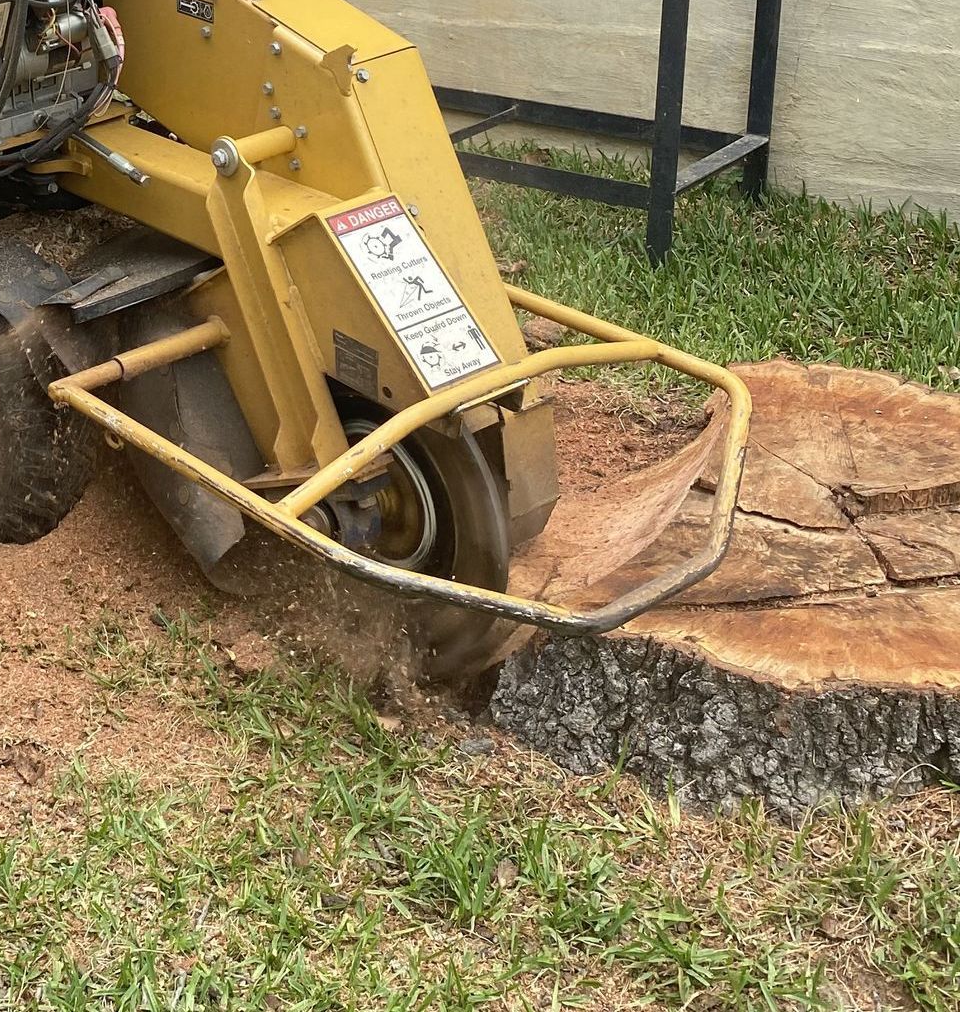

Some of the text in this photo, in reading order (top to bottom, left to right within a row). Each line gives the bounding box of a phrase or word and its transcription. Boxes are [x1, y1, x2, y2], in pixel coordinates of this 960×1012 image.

[347, 201, 401, 227] DANGER
[370, 256, 428, 280] Rotating Cutters
[396, 296, 451, 321] Thrown Objects
[403, 313, 467, 342] Keep Guard Down
[444, 358, 482, 377] Stay Away
